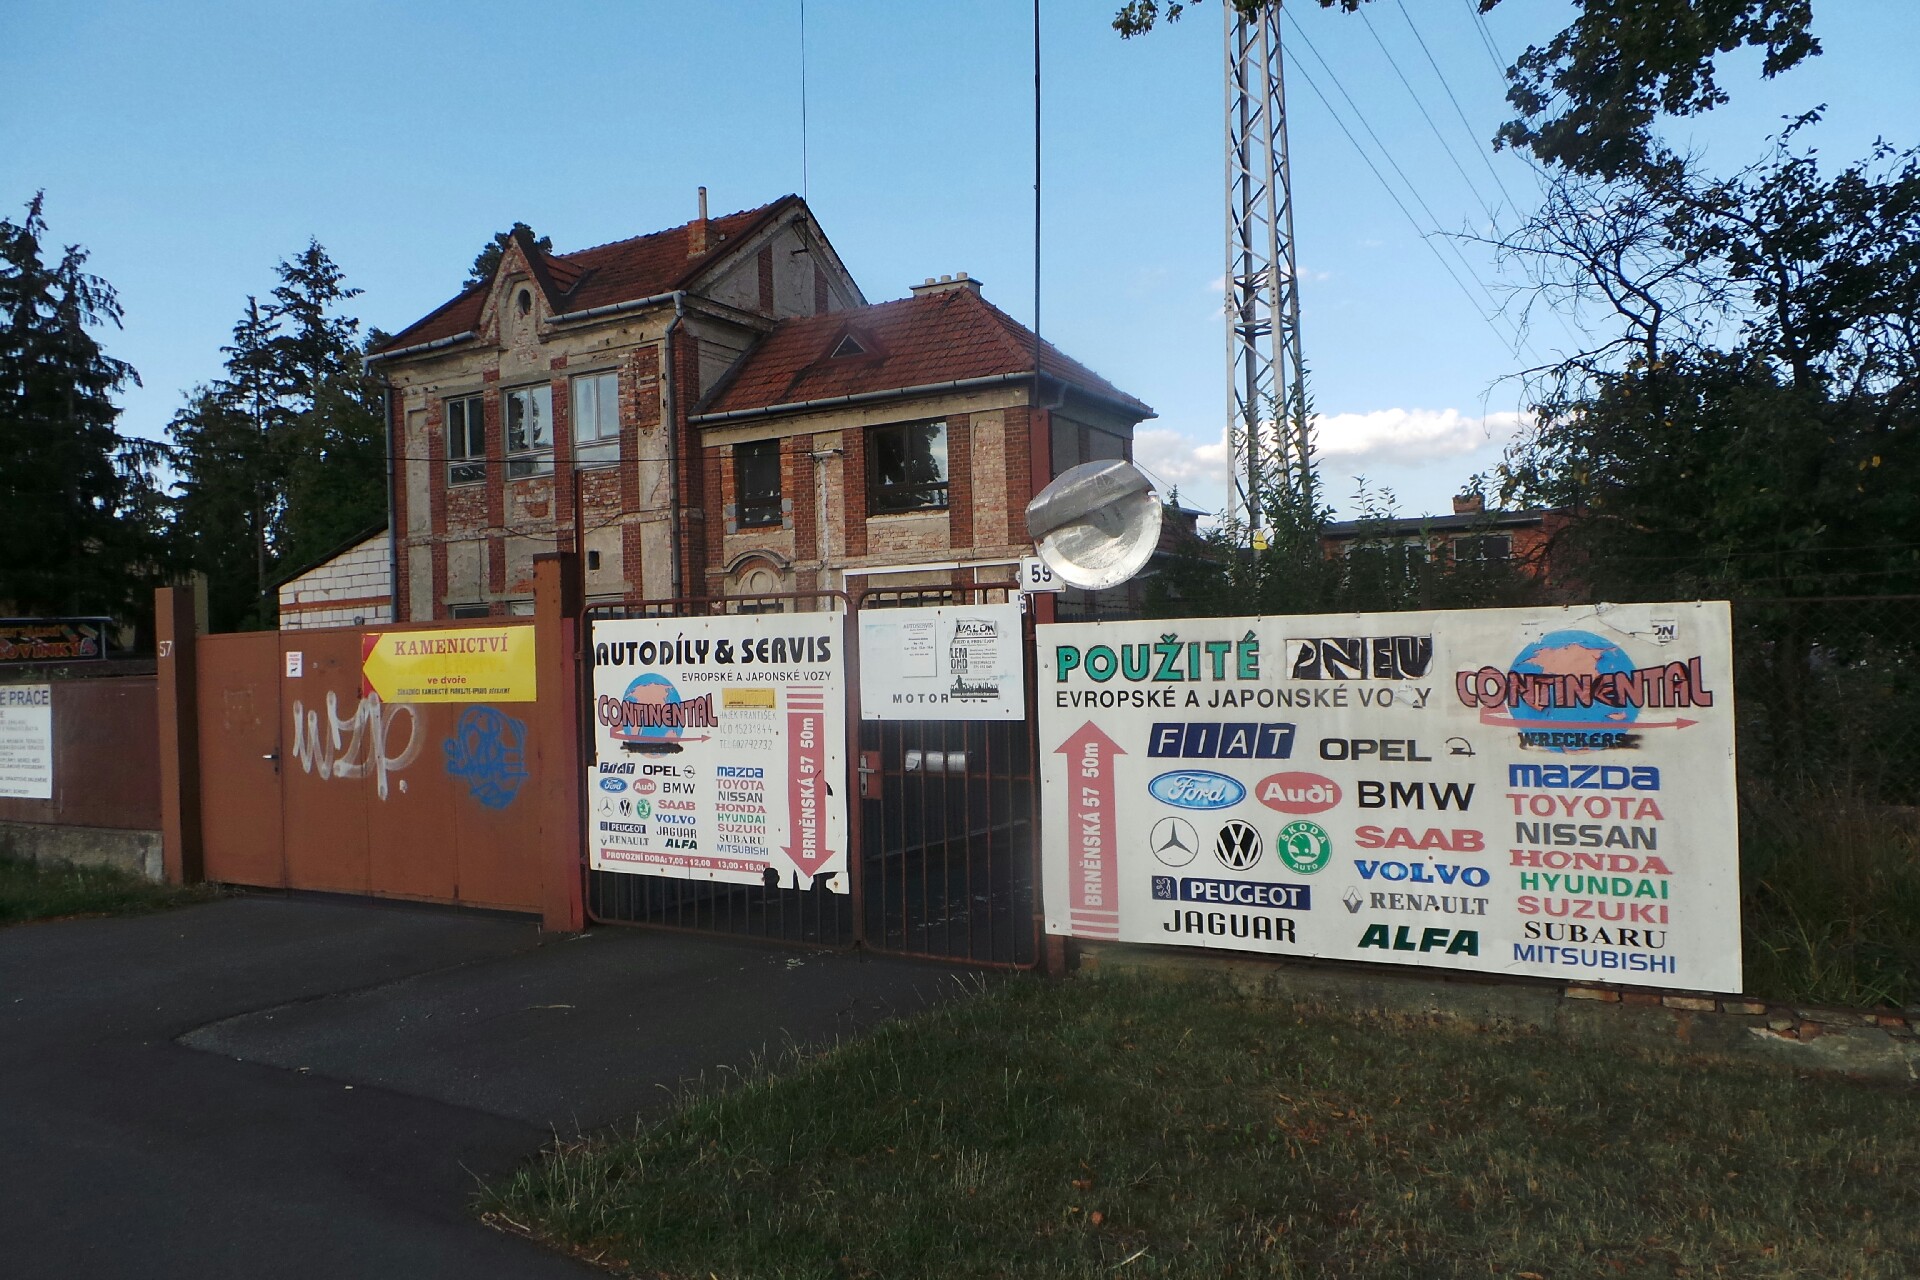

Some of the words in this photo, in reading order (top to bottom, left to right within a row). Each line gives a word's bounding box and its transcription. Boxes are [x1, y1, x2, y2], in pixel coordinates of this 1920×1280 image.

[1031, 564, 1052, 583] 59
[159, 641, 172, 657] 57
[394, 633, 508, 656] KAMENICTVÍ
[596, 632, 710, 666] AUTODÍLY
[714, 639, 735, 665] &
[741, 636, 831, 664] SERVIS
[1056, 629, 1260, 683] POUŽITÉ
[1286, 636, 1433, 681] PNEU
[427, 676, 438, 685] ve
[440, 675, 467, 685] dvoře
[682, 669, 732, 682] EVROPSKÉ
[736, 672, 743, 681] A
[745, 668, 800, 681] JAPONSKÉ
[803, 670, 832, 681] VOZY
[1456, 656, 1713, 709] CONTINENTAL
[9, 687, 49, 705] PRÁCE
[892, 693, 949, 704] MOTOR
[1056, 685, 1176, 708] EVROPSKÉ
[1184, 689, 1200, 708] A
[1208, 683, 1349, 709] JAPONSKÉ
[1358, 687, 1432, 709] VOY
[597, 693, 719, 728] CONTINENTAL
[801, 718, 815, 749] 50m
[1152, 726, 1293, 757] FIAT
[1082, 742, 1100, 778] 50m
[1319, 738, 1433, 762] OPEL
[600, 762, 635, 775] FIAT
[642, 764, 681, 777] OPEL
[801, 756, 815, 774] 57
[663, 782, 696, 794] BMW
[716, 778, 765, 791] TOYOTA
[1262, 781, 1334, 805] Audi
[1357, 780, 1476, 811] BMW
[658, 799, 696, 811] SAAB
[715, 802, 767, 814] HONDA
[718, 790, 763, 803] NISSAN
[1083, 786, 1100, 808] 57
[1506, 793, 1665, 821] TOYOTA
[611, 823, 645, 833] PEUGEOT
[655, 813, 696, 825] VOLVO
[717, 813, 765, 824] HYUNDAI
[718, 823, 766, 834] SUZUKI
[797, 777, 816, 859] BRNĚNSKÁ
[609, 835, 650, 846] RENAULT
[656, 826, 697, 838] JAGUAR
[665, 838, 698, 849] ALFA
[719, 834, 765, 846] SUBARU
[1355, 825, 1485, 853] SAAB
[1515, 821, 1657, 851] NISSAN
[606, 851, 643, 861] PROVOZNÍ
[644, 854, 668, 864] DOBA:
[716, 844, 769, 856] MITSUBISHI
[1078, 812, 1103, 906] BRNĚNSKÁ
[1292, 862, 1318, 871] AUTO
[1353, 859, 1491, 887] VOLVO
[1509, 849, 1673, 875] HONDA
[1190, 881, 1302, 907] PEUGEOT
[1520, 871, 1669, 900] HYUNDAI
[1369, 891, 1489, 915] RENAULT
[1517, 895, 1669, 924] SUZUKI
[1163, 909, 1296, 944] JAGUAR
[1524, 920, 1667, 949] SUBARU
[1357, 923, 1479, 957] ALFA
[1513, 943, 1676, 974] MITSUBISHI
